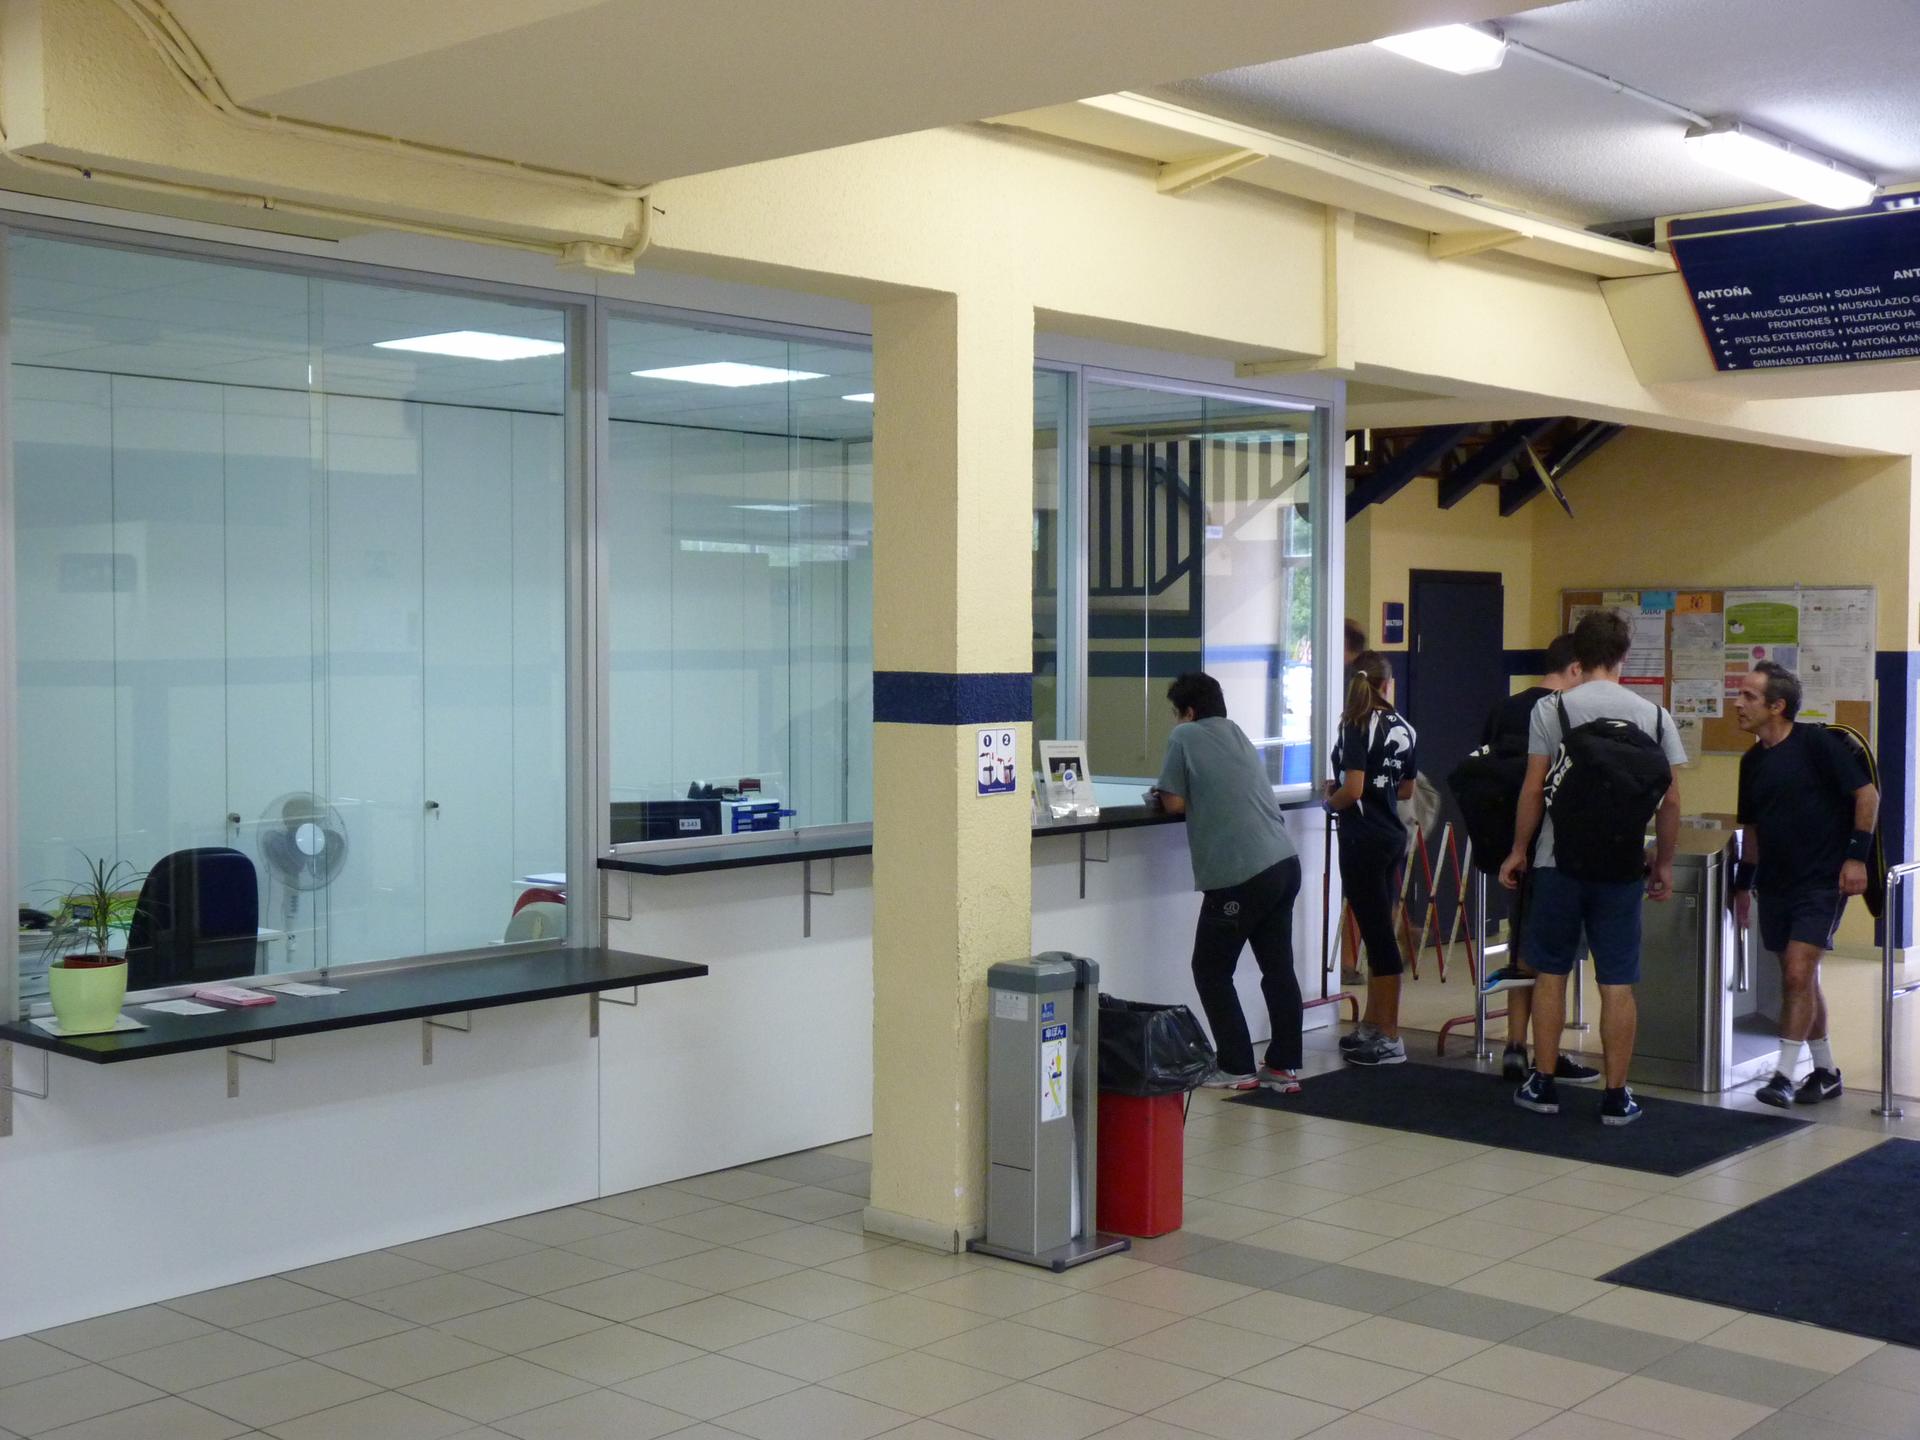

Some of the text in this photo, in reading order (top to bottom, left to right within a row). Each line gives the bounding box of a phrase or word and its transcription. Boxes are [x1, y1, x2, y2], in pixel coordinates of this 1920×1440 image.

[1697, 285, 1752, 300] ANTOÑA
[1778, 285, 1881, 303] SQUASH SQUASH
[1722, 312, 1750, 321] SALA
[1750, 304, 1827, 318] MUSCULACION
[1838, 296, 1910, 310] MUSKULAZIO
[1768, 309, 1916, 329] FRONTONES PILOTALEKUA
[1735, 334, 1770, 344] PISTAS
[1772, 329, 1835, 342] EXTERIORES
[1846, 322, 1900, 335] KANPOKO
[1749, 345, 1794, 355] CANCHA
[1795, 340, 1840, 352] ANTOÑA
[1851, 335, 1897, 347] ANTOÑA
[1753, 356, 1804, 367] GIMNASIO
[1805, 353, 1843, 364] TATAMI
